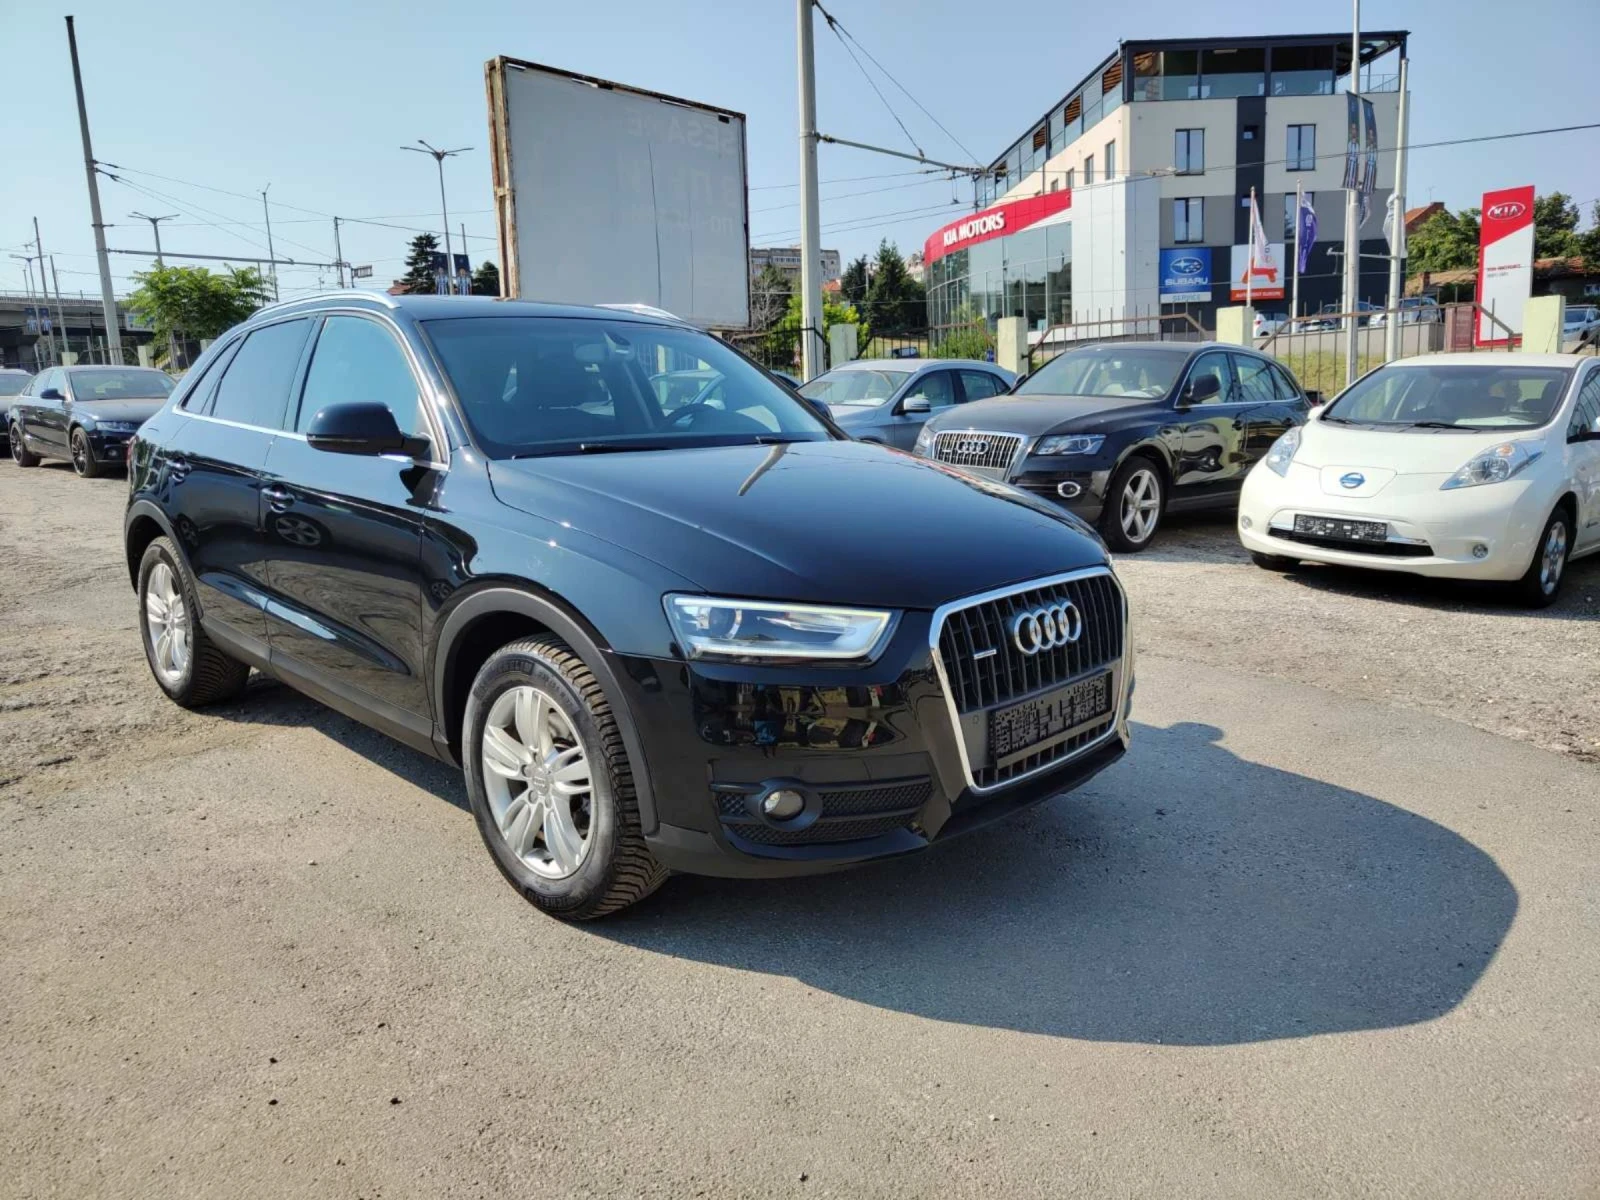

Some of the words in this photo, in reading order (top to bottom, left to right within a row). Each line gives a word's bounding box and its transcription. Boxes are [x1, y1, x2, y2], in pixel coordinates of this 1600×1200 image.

[944, 229, 958, 246] KIA
[959, 212, 1004, 238] MOTORS
[1164, 277, 1208, 286] SUBARU
